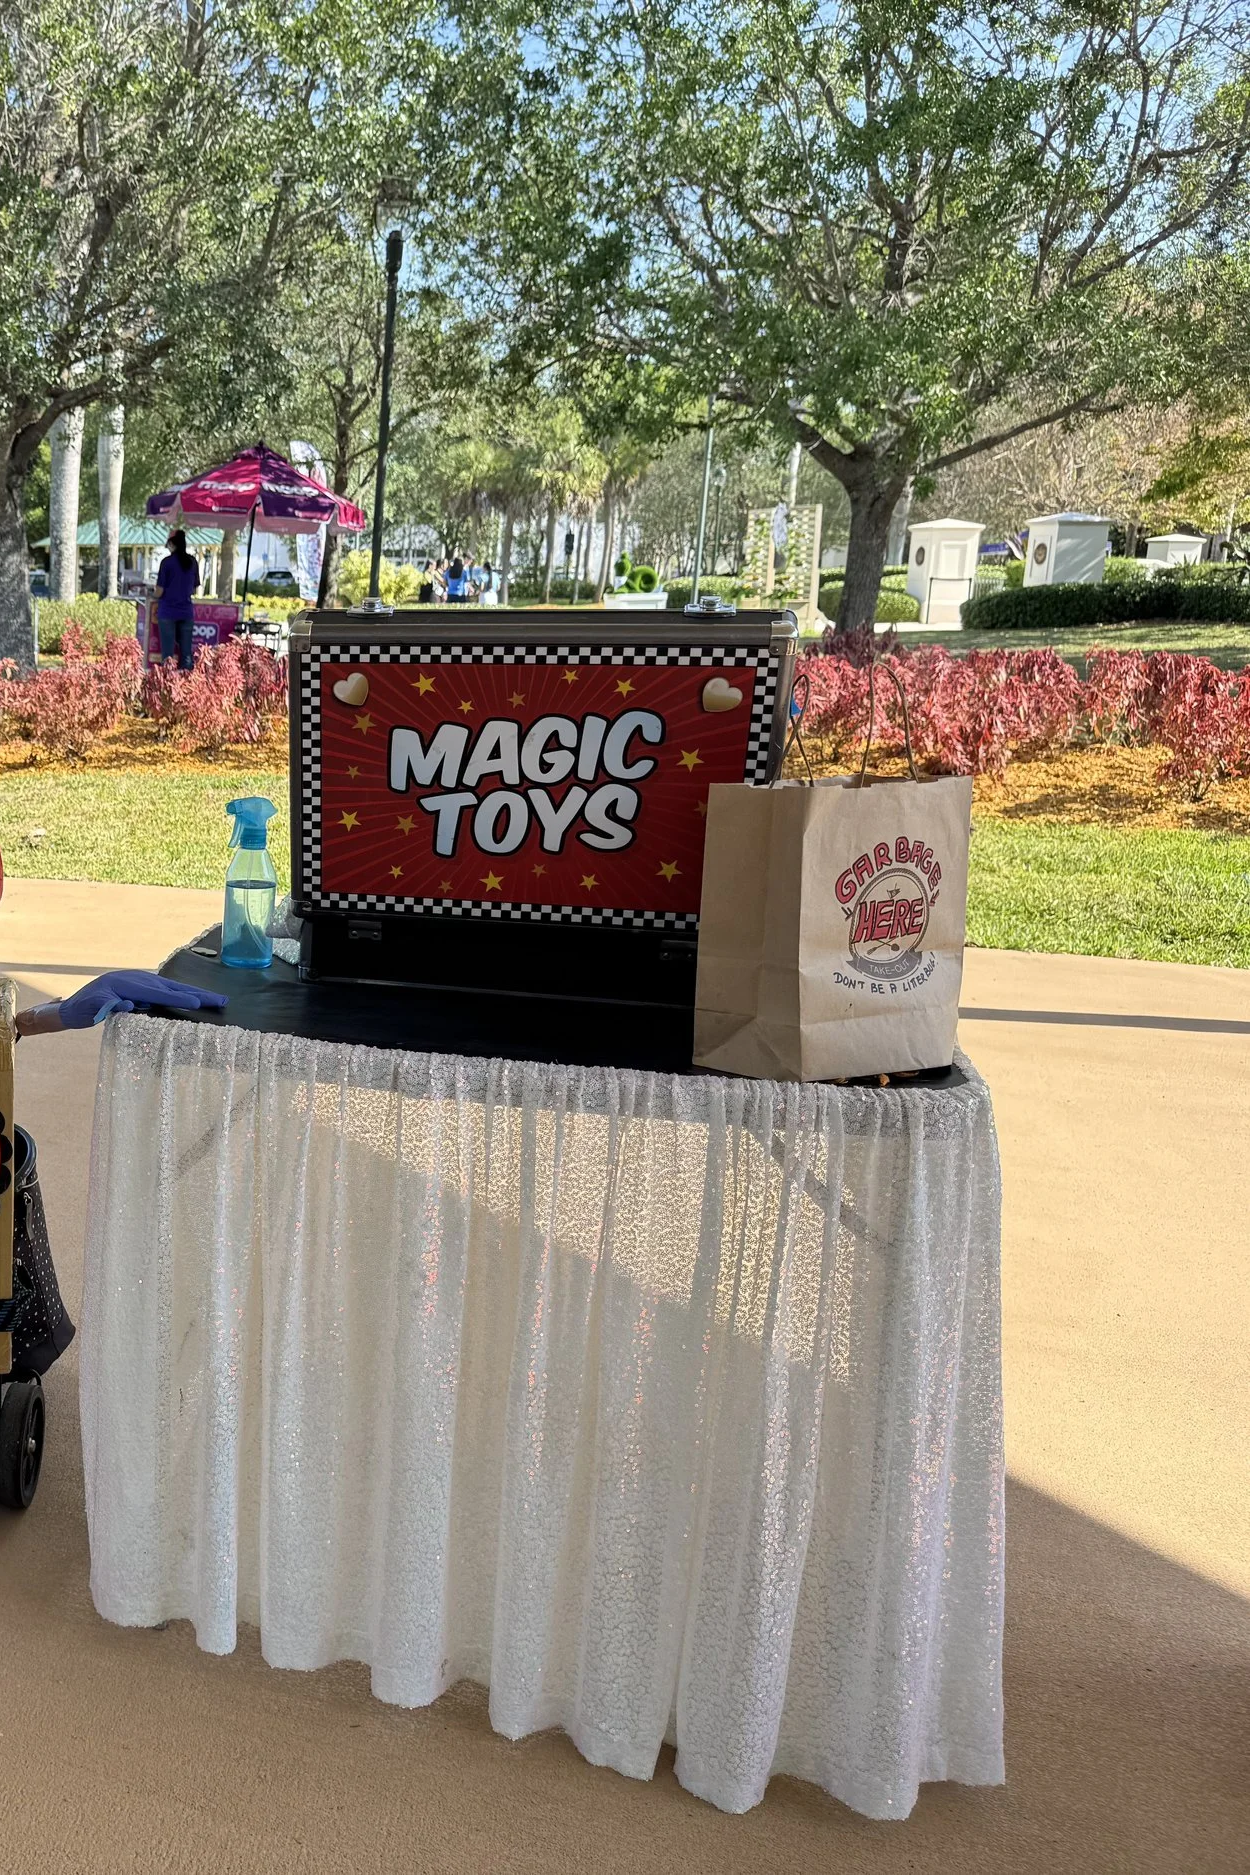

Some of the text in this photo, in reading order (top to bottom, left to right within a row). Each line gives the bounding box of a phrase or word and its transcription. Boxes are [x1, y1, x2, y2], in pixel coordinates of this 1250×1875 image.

[192, 624, 216, 640] oop
[388, 708, 665, 793] MAGIC
[417, 782, 641, 858] TOYS
[835, 836, 942, 905] GARBAGE
[851, 897, 924, 944] HERE
[869, 958, 910, 975] TAKE-OUT
[870, 982, 885, 994] BE
[889, 983, 897, 994] A
